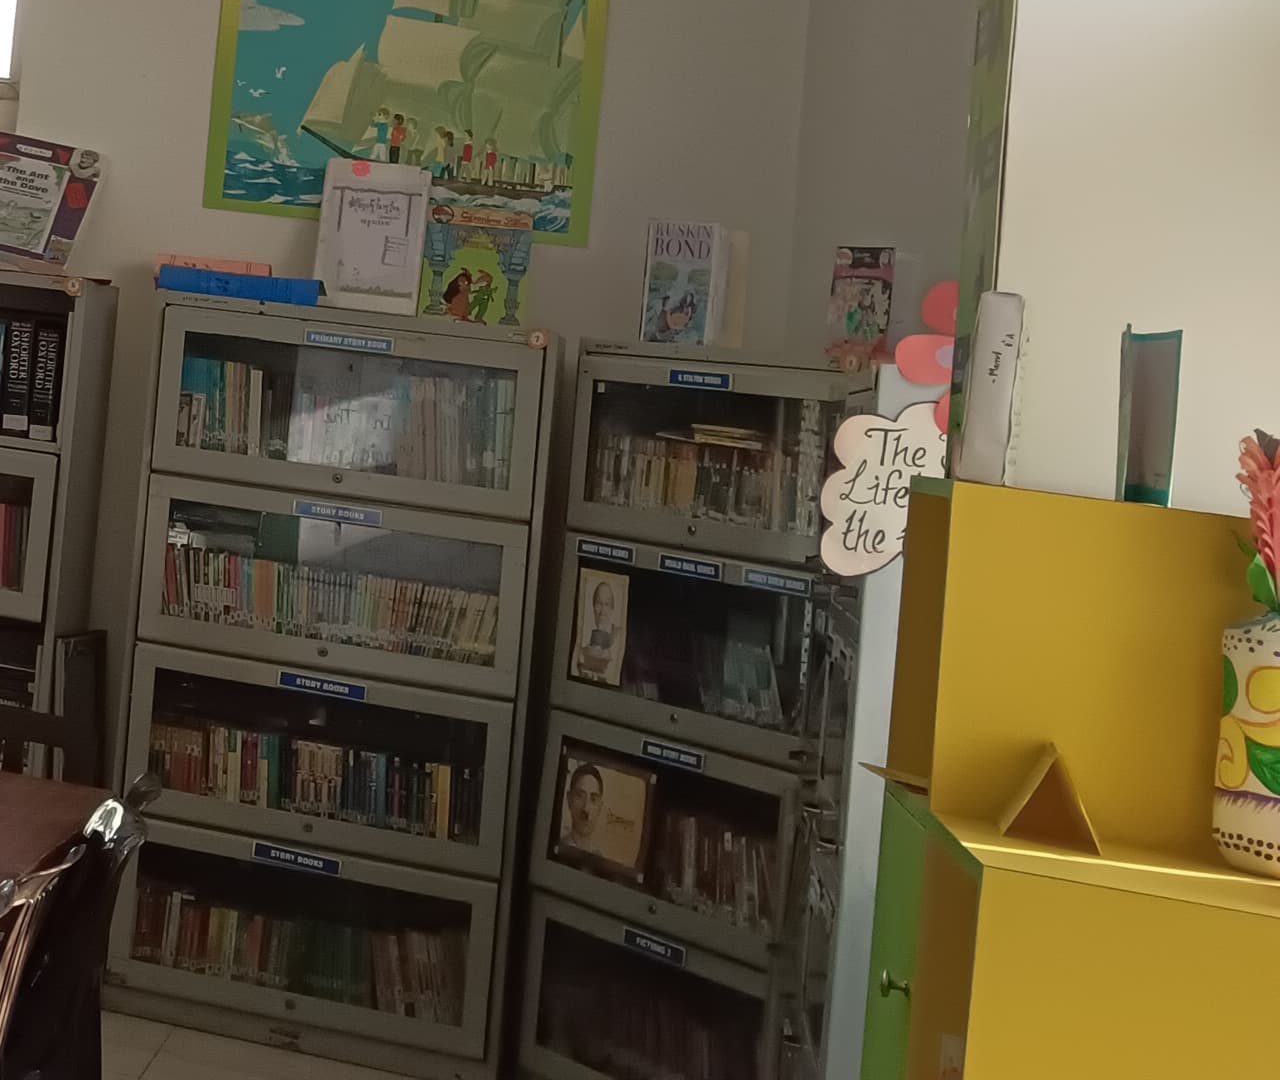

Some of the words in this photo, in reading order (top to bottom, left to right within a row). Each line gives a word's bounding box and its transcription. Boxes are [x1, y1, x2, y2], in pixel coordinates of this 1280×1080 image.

[6, 165, 27, 176] The
[29, 170, 50, 180] Ant
[19, 183, 49, 194] Dove
[655, 222, 713, 239] RUSKIN
[654, 237, 711, 259] BOND
[311, 333, 343, 344] PRIMARY
[343, 336, 366, 347] STORY
[9, 330, 21, 379] OXFORD
[19, 331, 31, 380] SHORTER
[35, 340, 48, 389] OXFORD
[864, 427, 926, 469] The
[839, 459, 909, 509] Life
[311, 506, 336, 516] STORY
[337, 510, 365, 520] BOOKS
[841, 510, 886, 554] the
[295, 677, 321, 690] STORY
[322, 680, 350, 694] BOOKS
[270, 849, 296, 862] STORY
[297, 854, 324, 869] BOOKS
